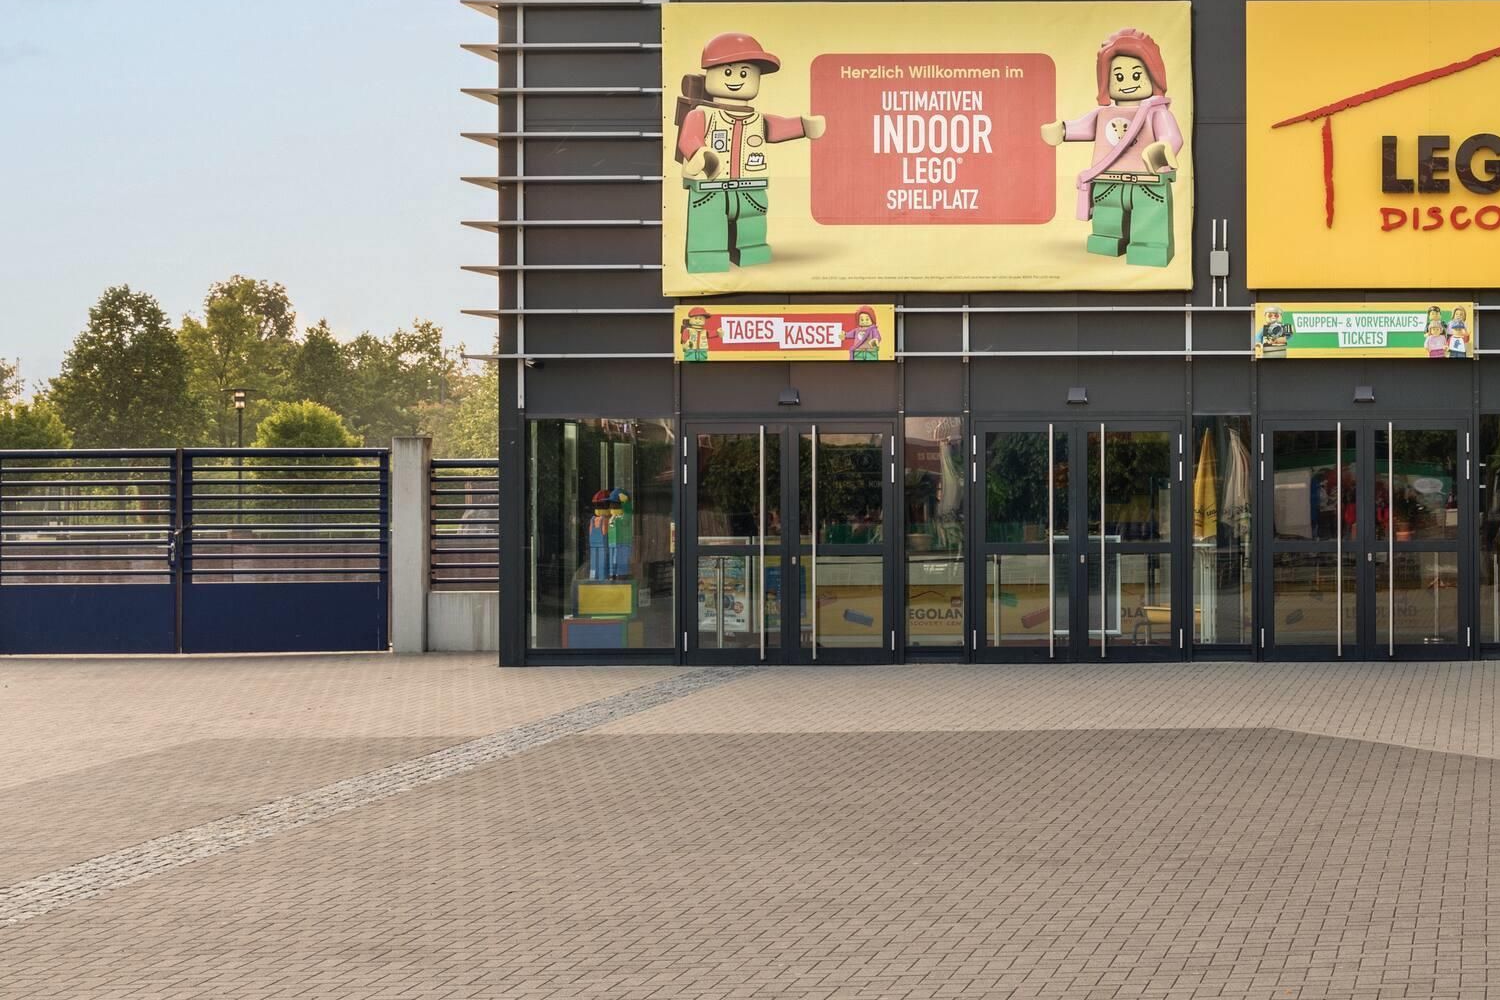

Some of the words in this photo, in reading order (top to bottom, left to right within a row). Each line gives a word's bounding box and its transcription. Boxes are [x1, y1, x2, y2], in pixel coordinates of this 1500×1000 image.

[840, 65, 904, 79] Herzlich
[908, 65, 1000, 79] Willkommen
[1005, 66, 1024, 79] im
[881, 90, 983, 112] ULTIMATIVEN
[873, 114, 993, 154] INDOOR
[886, 189, 979, 210] SPIELPLATZ
[1296, 315, 1343, 328] GRUPPEN-
[1346, 315, 1352, 328] &
[1356, 315, 1424, 328] VORVERKAUFS-
[726, 320, 774, 340] TAGES
[784, 325, 835, 345] KASSE
[1341, 331, 1384, 345] TICKETS
[909, 608, 963, 620] EGOLAN
